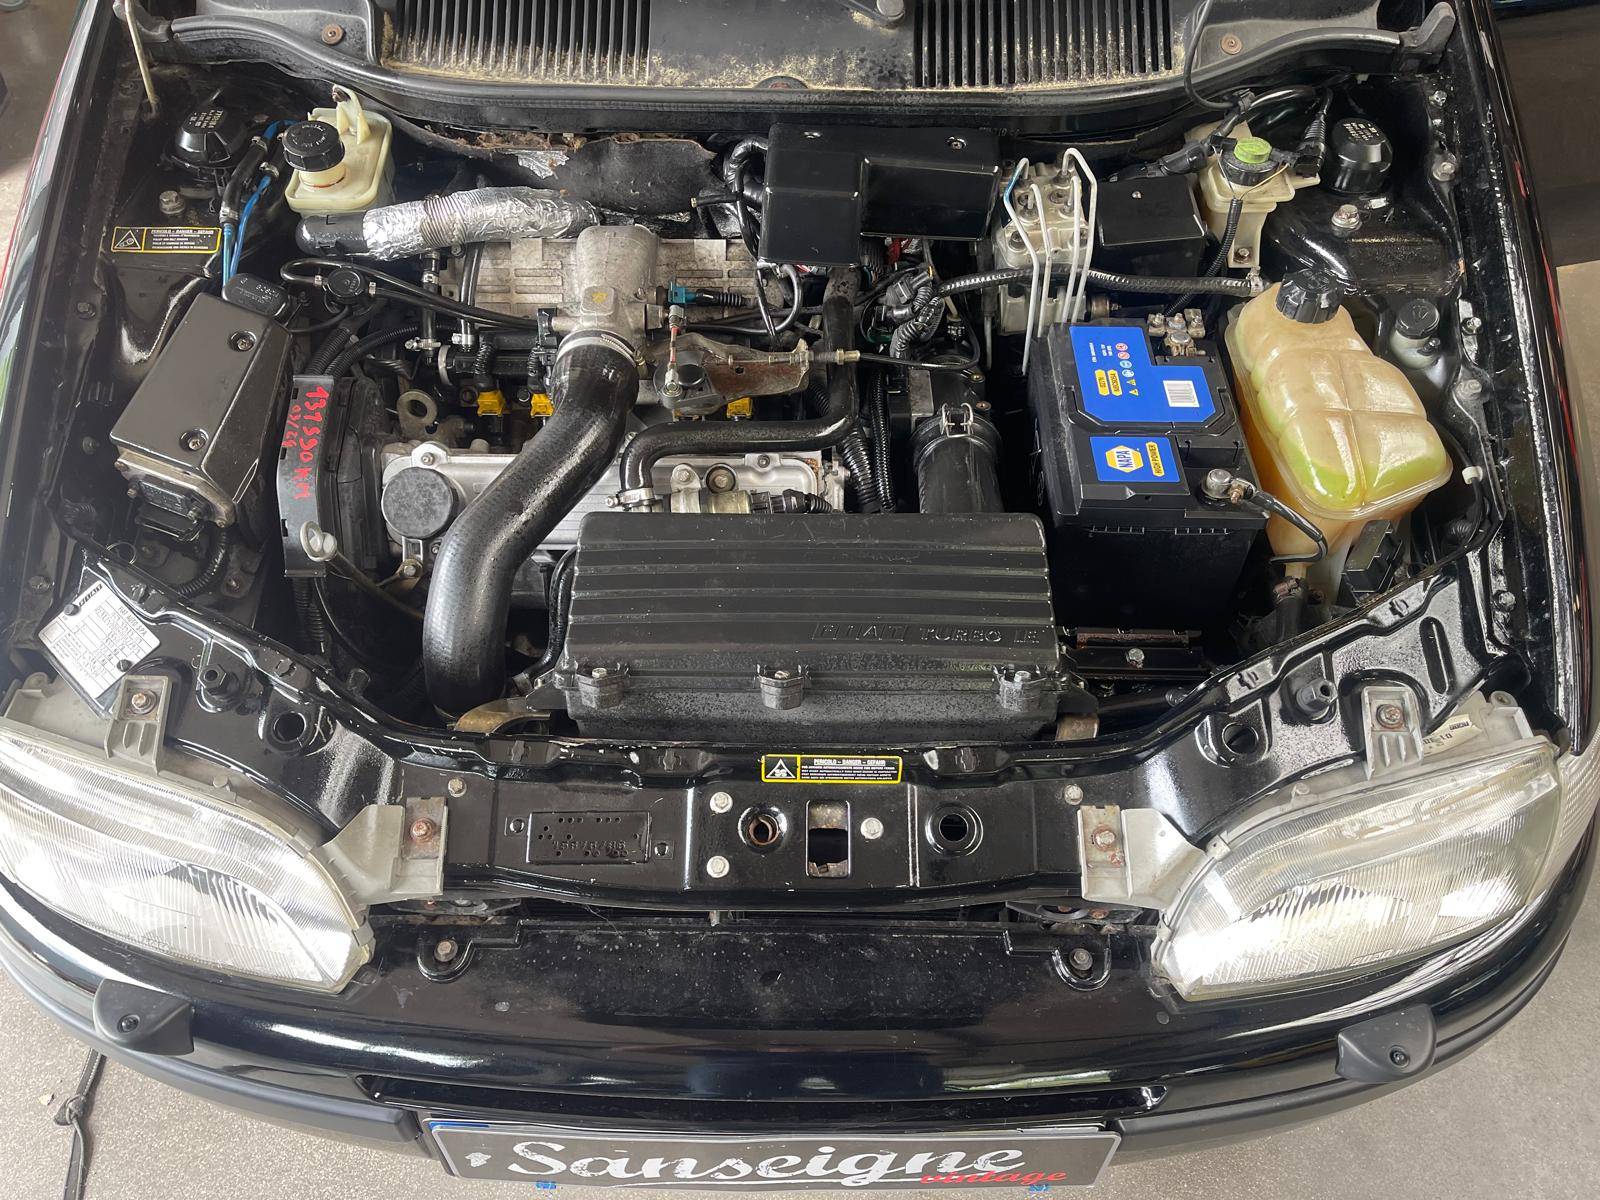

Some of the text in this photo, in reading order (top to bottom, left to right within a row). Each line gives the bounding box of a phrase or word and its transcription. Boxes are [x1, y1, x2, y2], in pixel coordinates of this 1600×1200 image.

[1115, 450, 1134, 468] NAPA
[918, 626, 1003, 643] TURBO
[507, 1141, 1026, 1186] Sanseigne
[919, 1169, 1068, 1185] vintage
